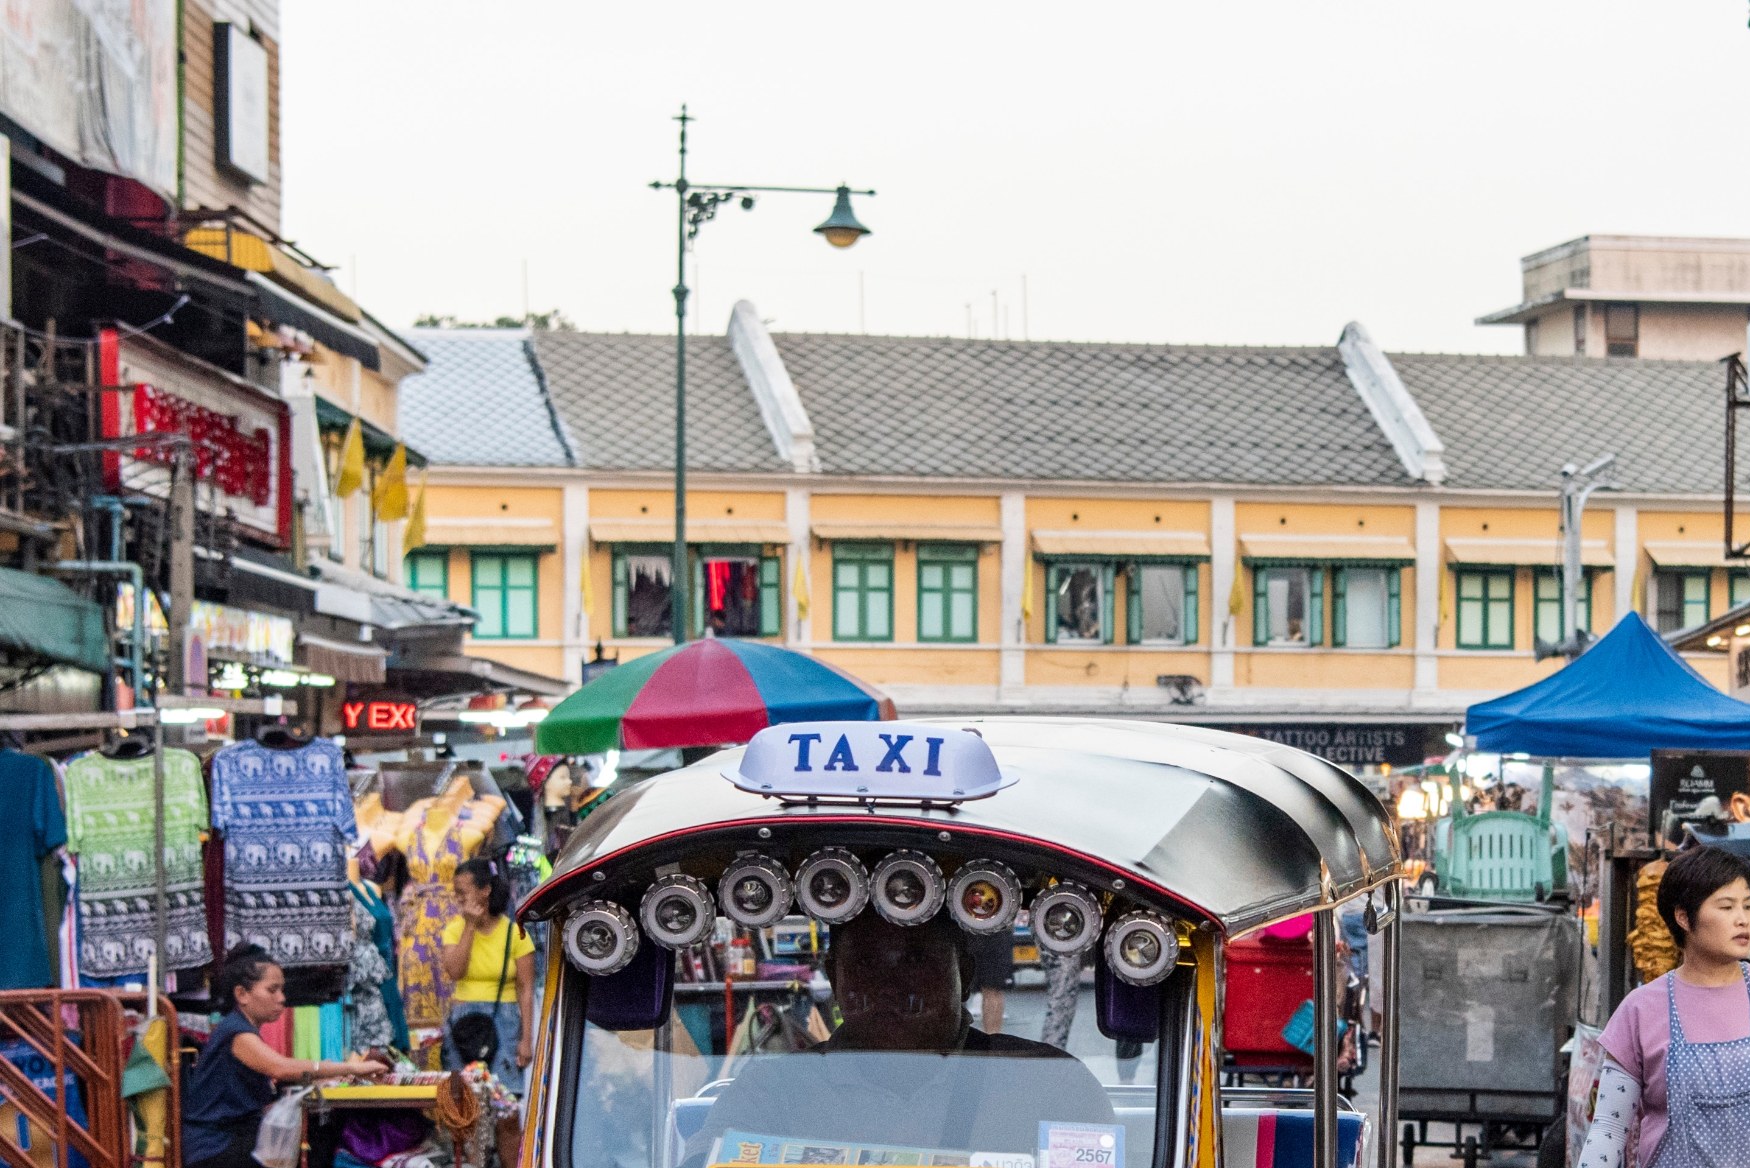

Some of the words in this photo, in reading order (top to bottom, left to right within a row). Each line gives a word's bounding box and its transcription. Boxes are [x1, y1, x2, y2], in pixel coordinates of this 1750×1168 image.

[1264, 730, 1329, 745] TATTOO
[1334, 731, 1404, 746] ARTISTS
[788, 731, 946, 778] TAXI
[1075, 1148, 1112, 1165] 2567
